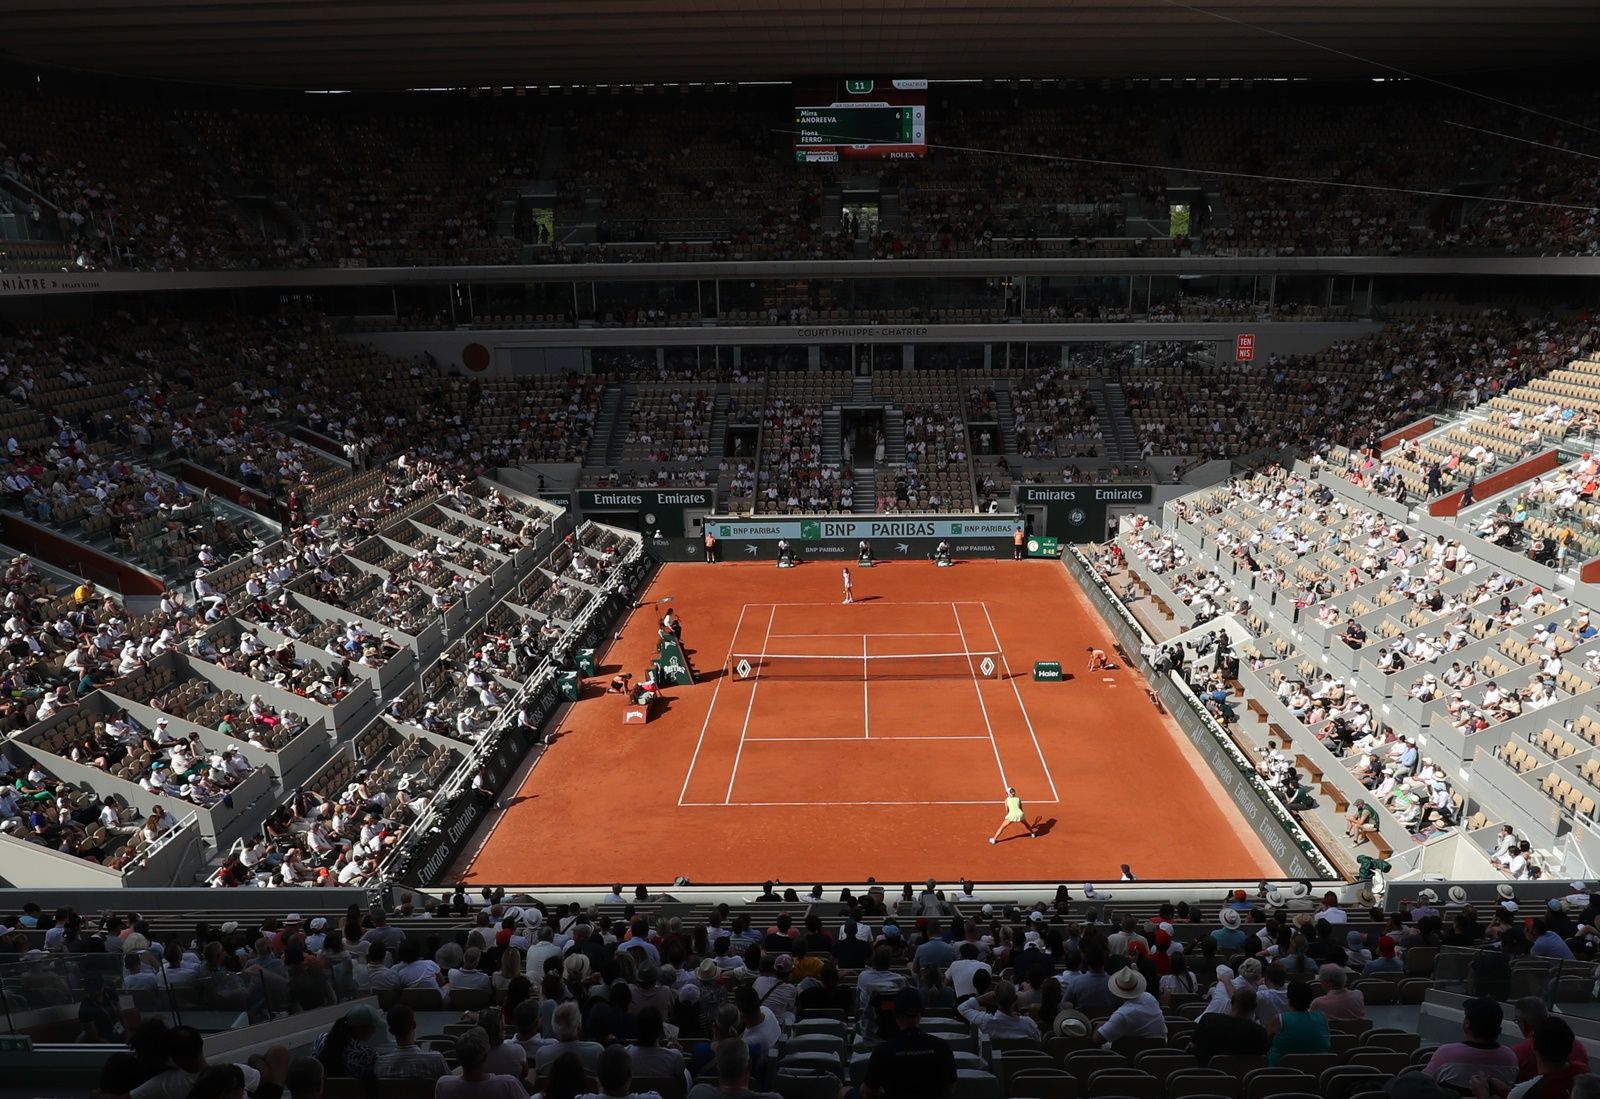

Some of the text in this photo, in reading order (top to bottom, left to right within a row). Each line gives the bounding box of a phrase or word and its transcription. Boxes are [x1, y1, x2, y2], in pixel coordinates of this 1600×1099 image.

[855, 82, 865, 90] 11
[798, 329, 829, 337] COURT
[881, 328, 928, 336] CHATRIER
[1240, 338, 1251, 346] TEN
[1239, 349, 1251, 357] NIS
[594, 493, 642, 505] Emirates
[657, 493, 705, 504] Emirates
[1028, 489, 1076, 500] Emirates
[1095, 488, 1143, 500] Emirates
[733, 527, 781, 535] BNP PARIBAS
[825, 522, 936, 536] BNP PARIBAS
[1234, 781, 1258, 819] Emirates
[447, 803, 477, 844] Emirates
[1259, 815, 1287, 858] Emirates
[417, 842, 451, 887] Emirates
